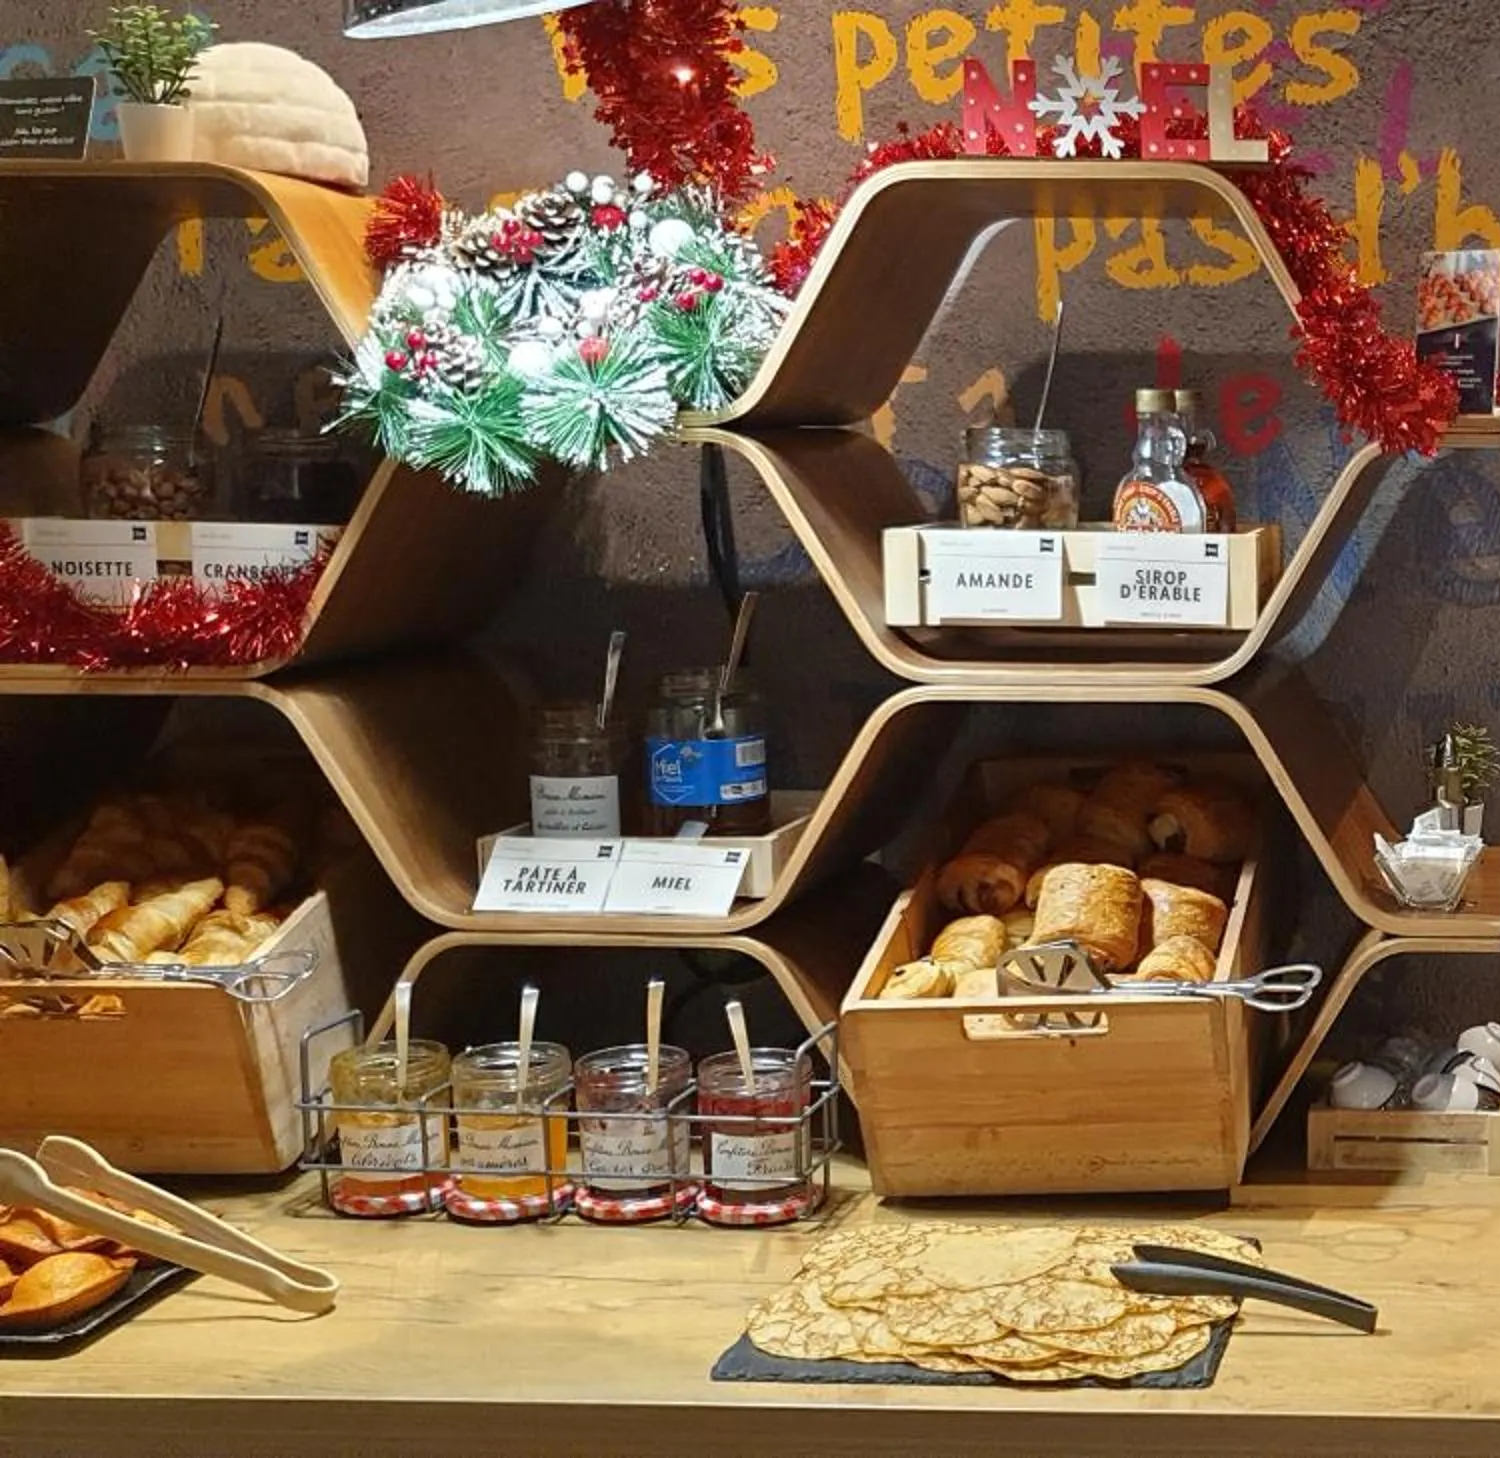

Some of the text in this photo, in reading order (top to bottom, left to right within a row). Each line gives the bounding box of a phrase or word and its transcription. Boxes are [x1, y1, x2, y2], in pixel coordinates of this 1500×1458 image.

[832, 4, 1361, 144] petites
[1034, 208, 1262, 326] pas
[52, 561, 133, 577] NOISETTE
[957, 573, 1034, 589] AMANDE
[1135, 569, 1187, 586] SIROP
[518, 865, 578, 881] PÂTE À
[503, 880, 587, 895] TARTINER
[651, 876, 692, 891] MIEL
